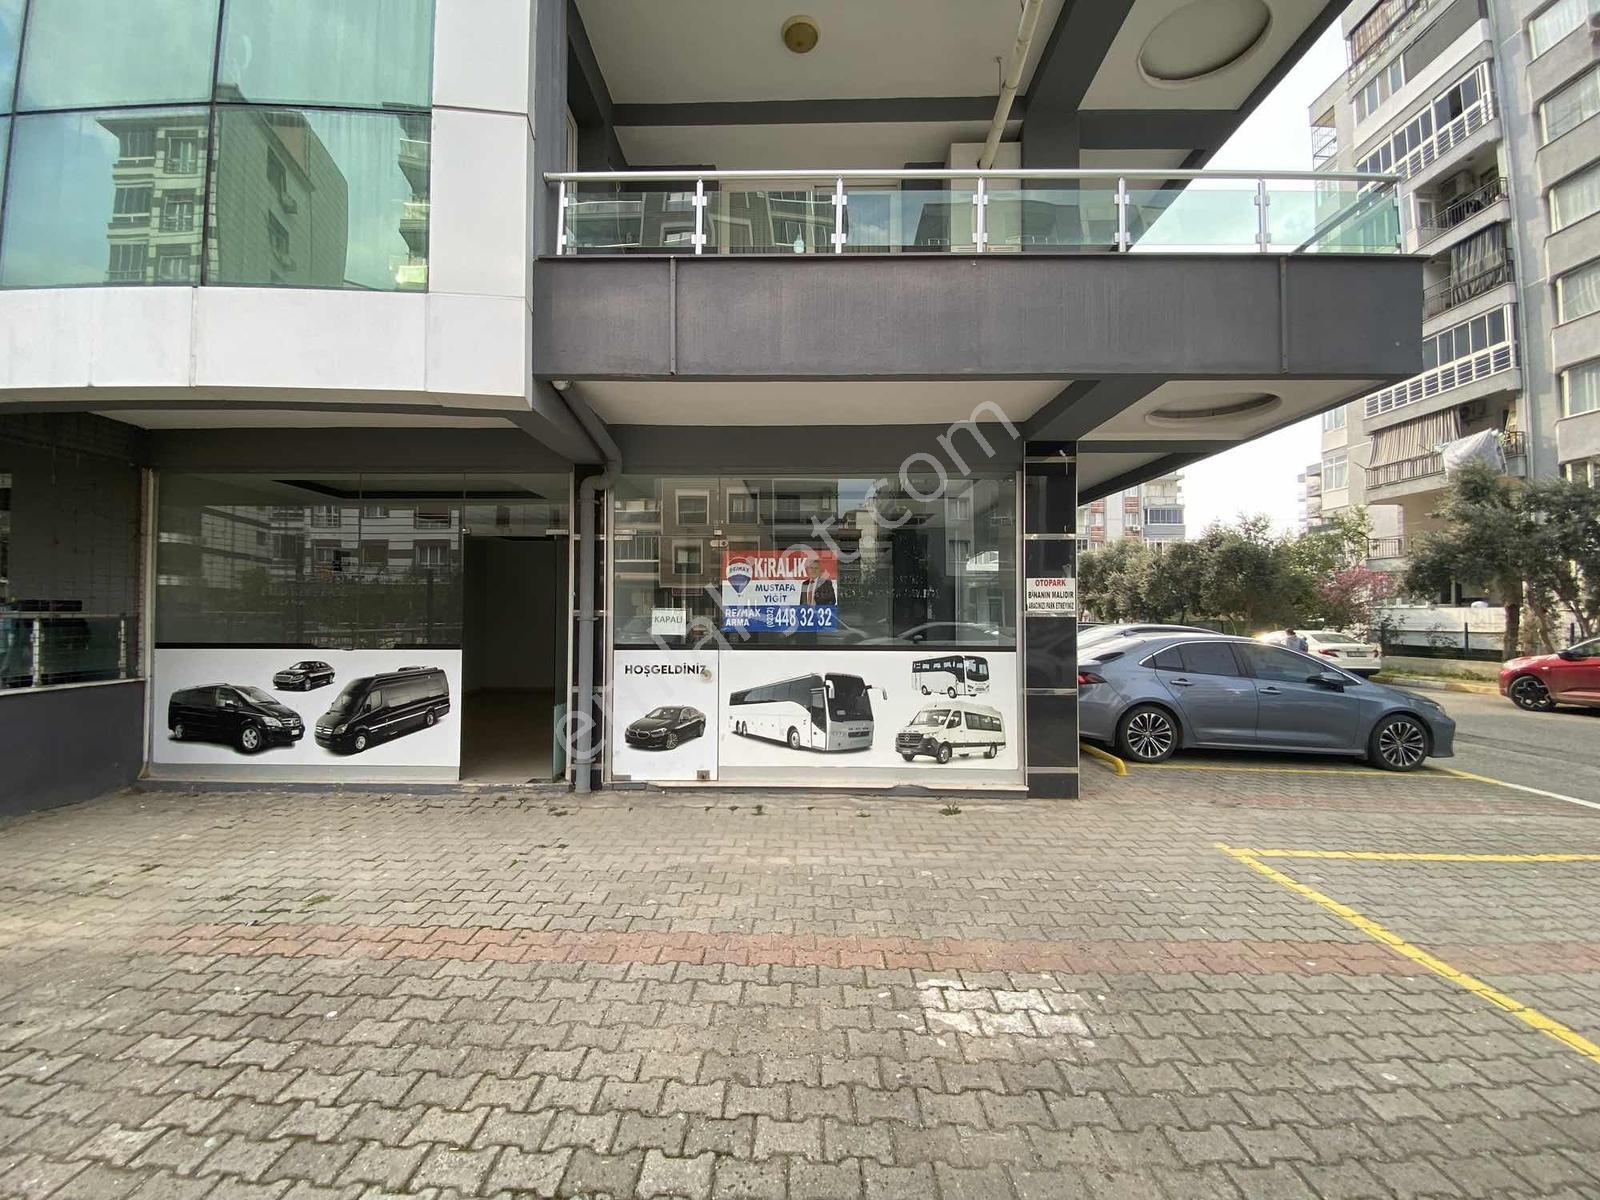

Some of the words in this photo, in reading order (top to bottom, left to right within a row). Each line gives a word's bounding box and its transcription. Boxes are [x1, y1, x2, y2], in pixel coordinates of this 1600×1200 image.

[755, 584, 796, 592] MUSTAFA
[725, 608, 760, 618] RE/MAX
[775, 607, 797, 627] 448
[800, 607, 814, 627] 32
[817, 607, 832, 627] 32
[654, 616, 683, 624] KAPALI
[725, 618, 750, 627] ARMA
[625, 662, 707, 677] HOŞGELDİNİZ
